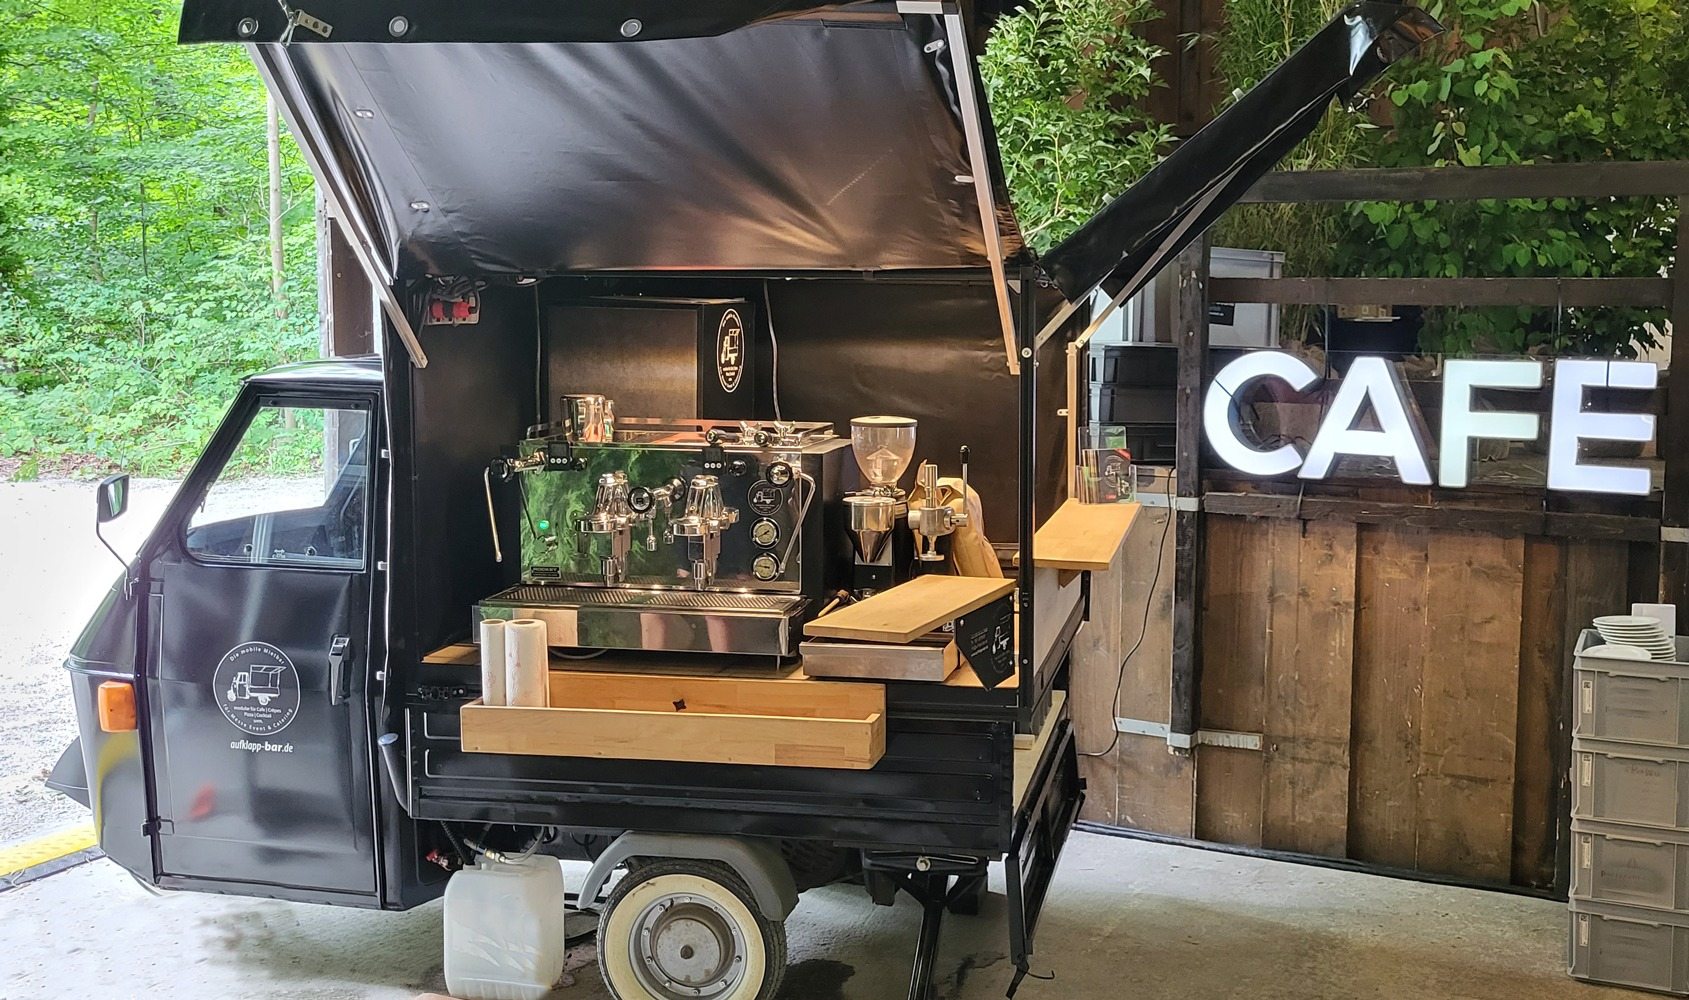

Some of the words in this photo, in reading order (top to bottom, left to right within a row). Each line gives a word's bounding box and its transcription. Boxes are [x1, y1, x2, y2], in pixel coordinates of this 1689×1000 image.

[1203, 350, 1658, 495] CAFE
[230, 653, 239, 662] Die
[263, 648, 284, 664] Mietbar
[273, 708, 293, 728] Catering
[230, 740, 294, 752] aufklapp-bar.de
